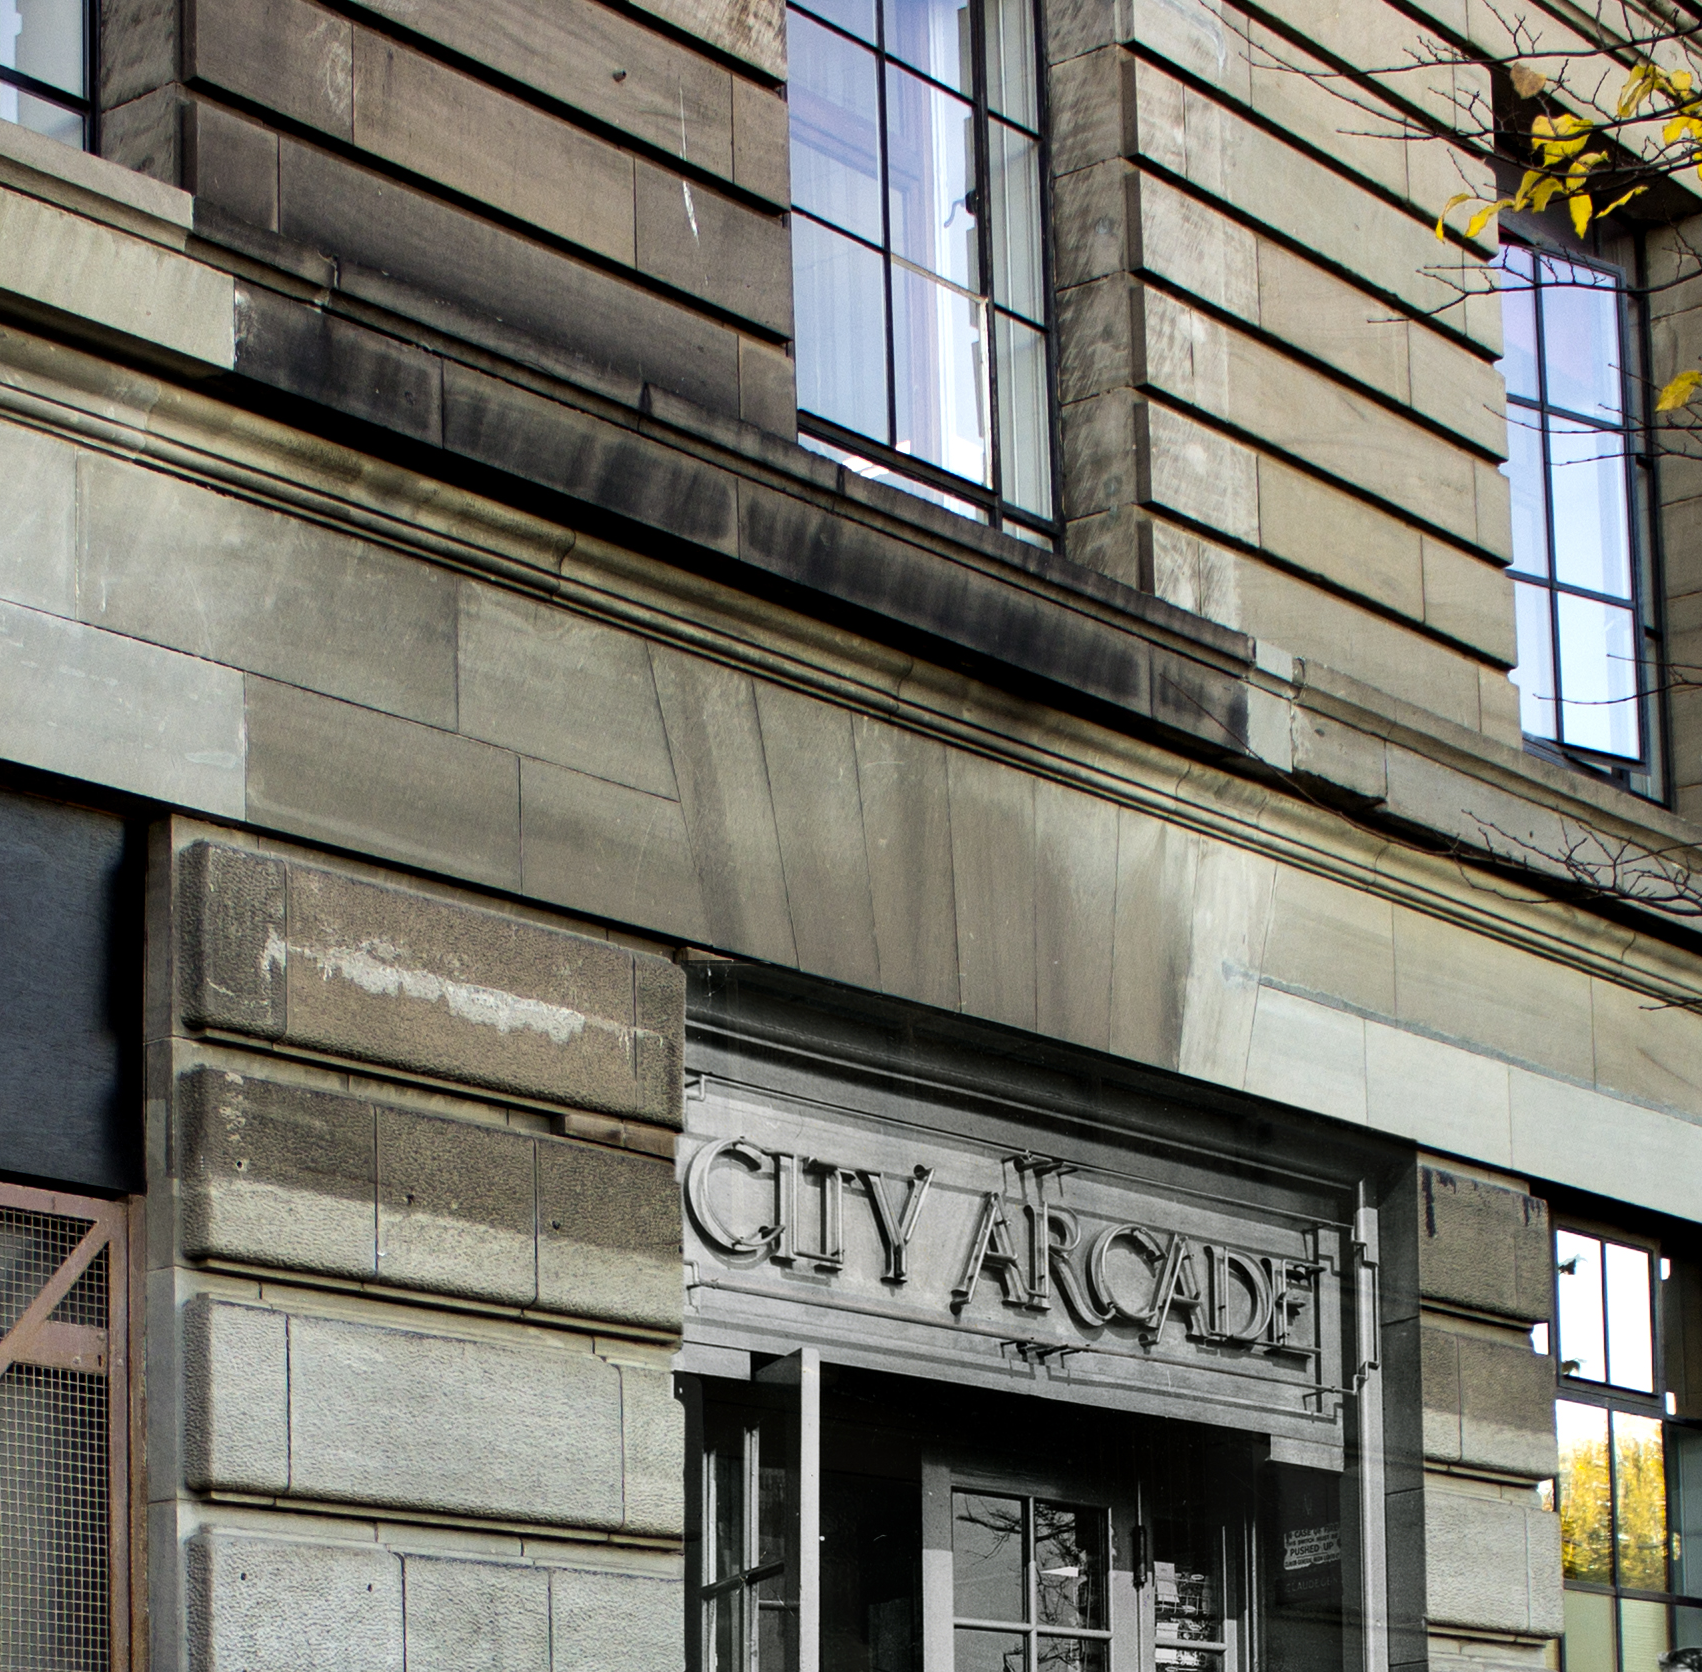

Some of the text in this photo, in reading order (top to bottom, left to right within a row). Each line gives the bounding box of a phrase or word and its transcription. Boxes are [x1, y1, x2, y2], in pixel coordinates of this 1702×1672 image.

[683, 1136, 1323, 1350] CITY ARCADE
[1294, 1528, 1311, 1538] CASE
[1290, 1541, 1334, 1556] PUSHED UP
